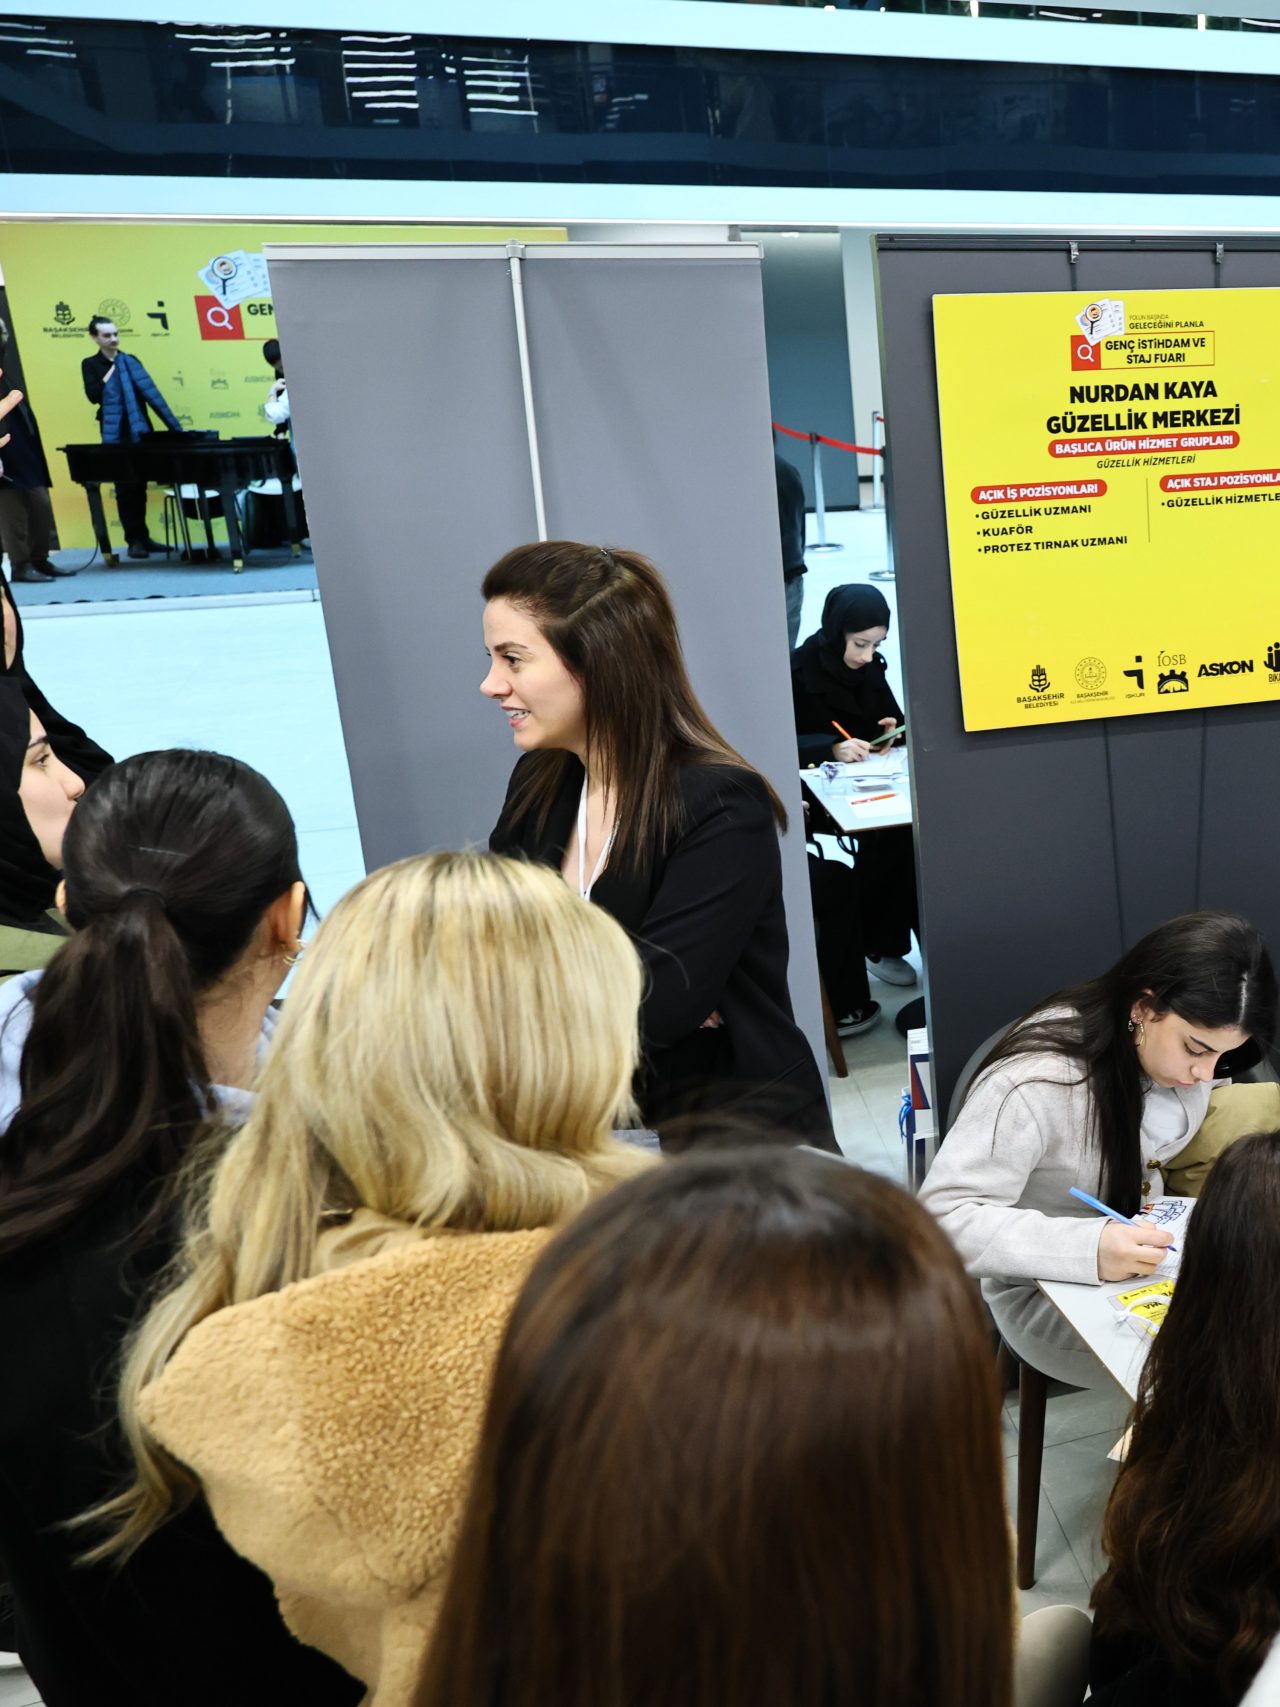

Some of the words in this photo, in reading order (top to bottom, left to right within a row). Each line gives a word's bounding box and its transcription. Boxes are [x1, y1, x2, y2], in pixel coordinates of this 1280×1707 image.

[1129, 321, 1174, 330] GELECEĞİNİ
[1105, 340, 1135, 353] GENÇ
[1192, 337, 1206, 348] VE
[1126, 353, 1152, 364] STAJ
[1154, 352, 1185, 363] FUARI
[1069, 382, 1159, 404] NURDAN
[1164, 380, 1217, 399] KAYA
[1046, 408, 1148, 434] GÜZELLİK
[1152, 404, 1240, 428] MERKEZİ
[1055, 442, 1103, 456] BAŞLICA
[1105, 438, 1137, 451] ÜRÜN
[1138, 436, 1179, 450] HİZMET
[1180, 434, 1233, 448] GRUPLARI
[1096, 456, 1141, 469] GÜZELLİK
[1143, 454, 1196, 466] HİZMETLERİ
[1167, 478, 1191, 490] AÇIK
[1193, 476, 1218, 488] STAJ
[979, 490, 1005, 501] AÇIK
[1007, 487, 1018, 500] İŞ
[1019, 484, 1098, 498] POZİSYONLARI
[1167, 495, 1223, 508] GÜZELLİK
[981, 506, 1042, 520] GÜZELLİK
[1044, 504, 1092, 516] UZMANI
[982, 524, 1033, 537] KUAFÖR
[983, 542, 1032, 554] PROTEZ
[1033, 538, 1079, 550] TIRNAK
[1081, 535, 1128, 547] UZMANI
[1197, 659, 1254, 678] ASKON
